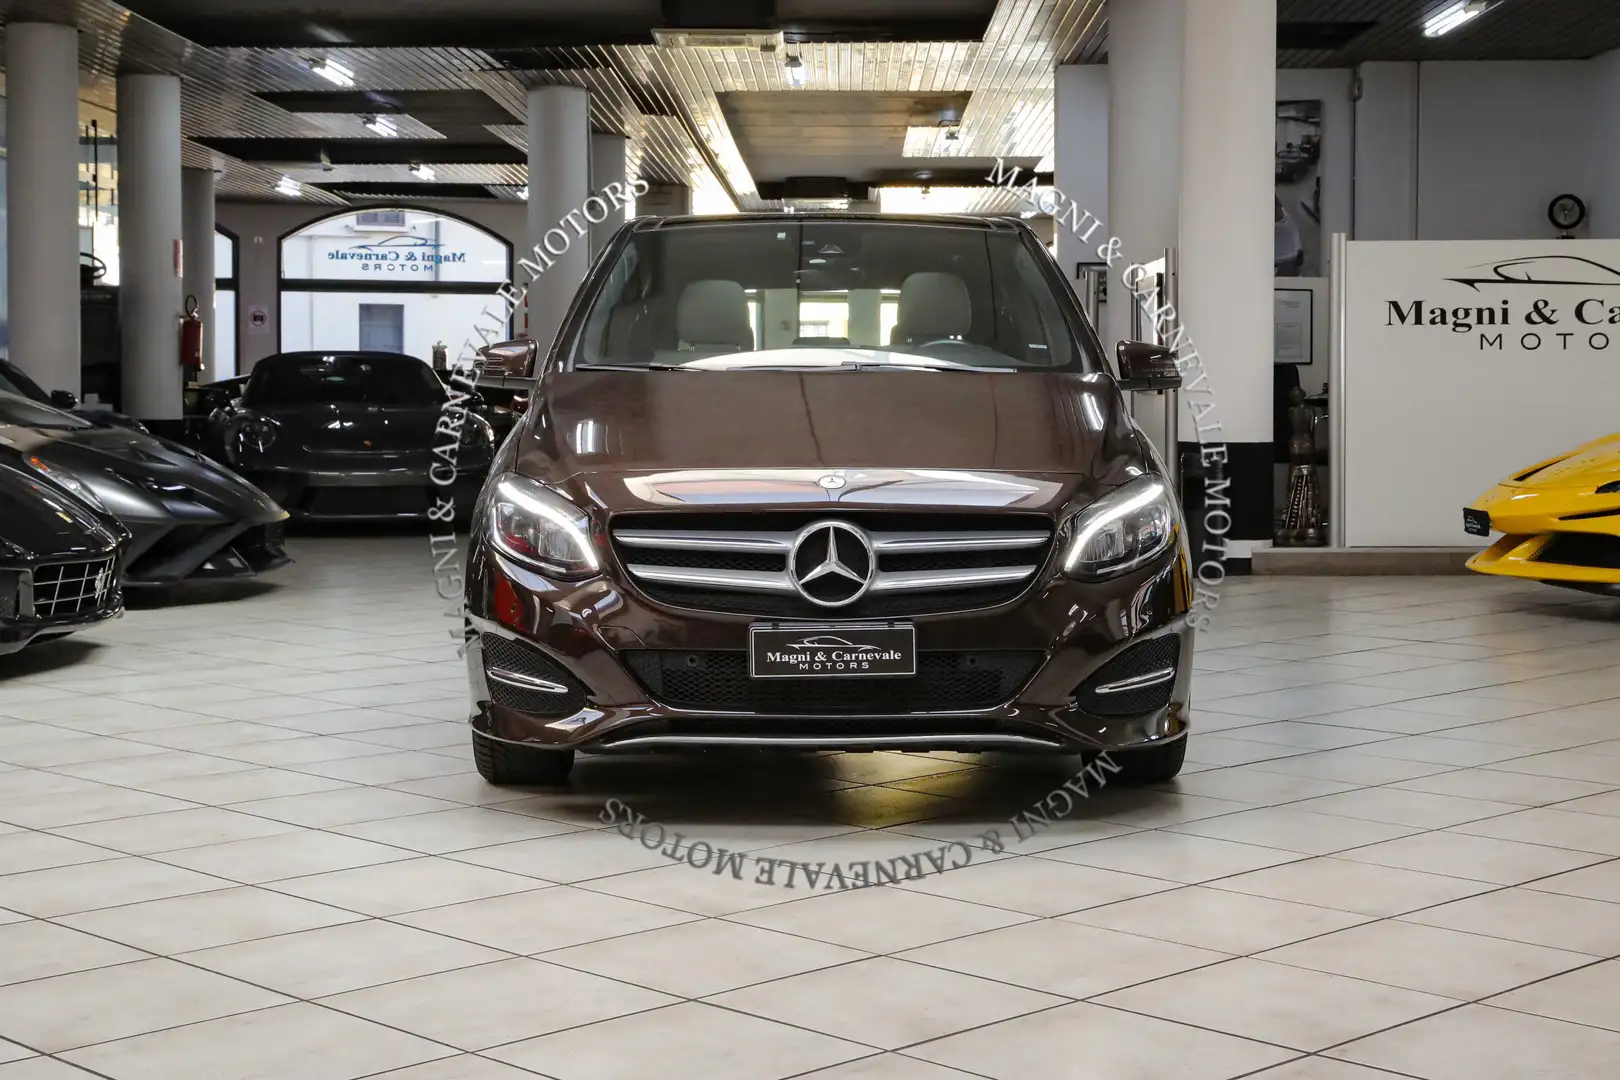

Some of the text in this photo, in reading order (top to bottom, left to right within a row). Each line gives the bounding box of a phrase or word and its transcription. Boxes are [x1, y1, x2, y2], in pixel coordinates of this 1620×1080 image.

[1385, 299, 1511, 333] Magni
[1524, 299, 1559, 325] &
[1480, 332, 1610, 350] MOTO
[766, 650, 902, 664] Magni & Carnevale
[799, 662, 870, 670] MOTORS
